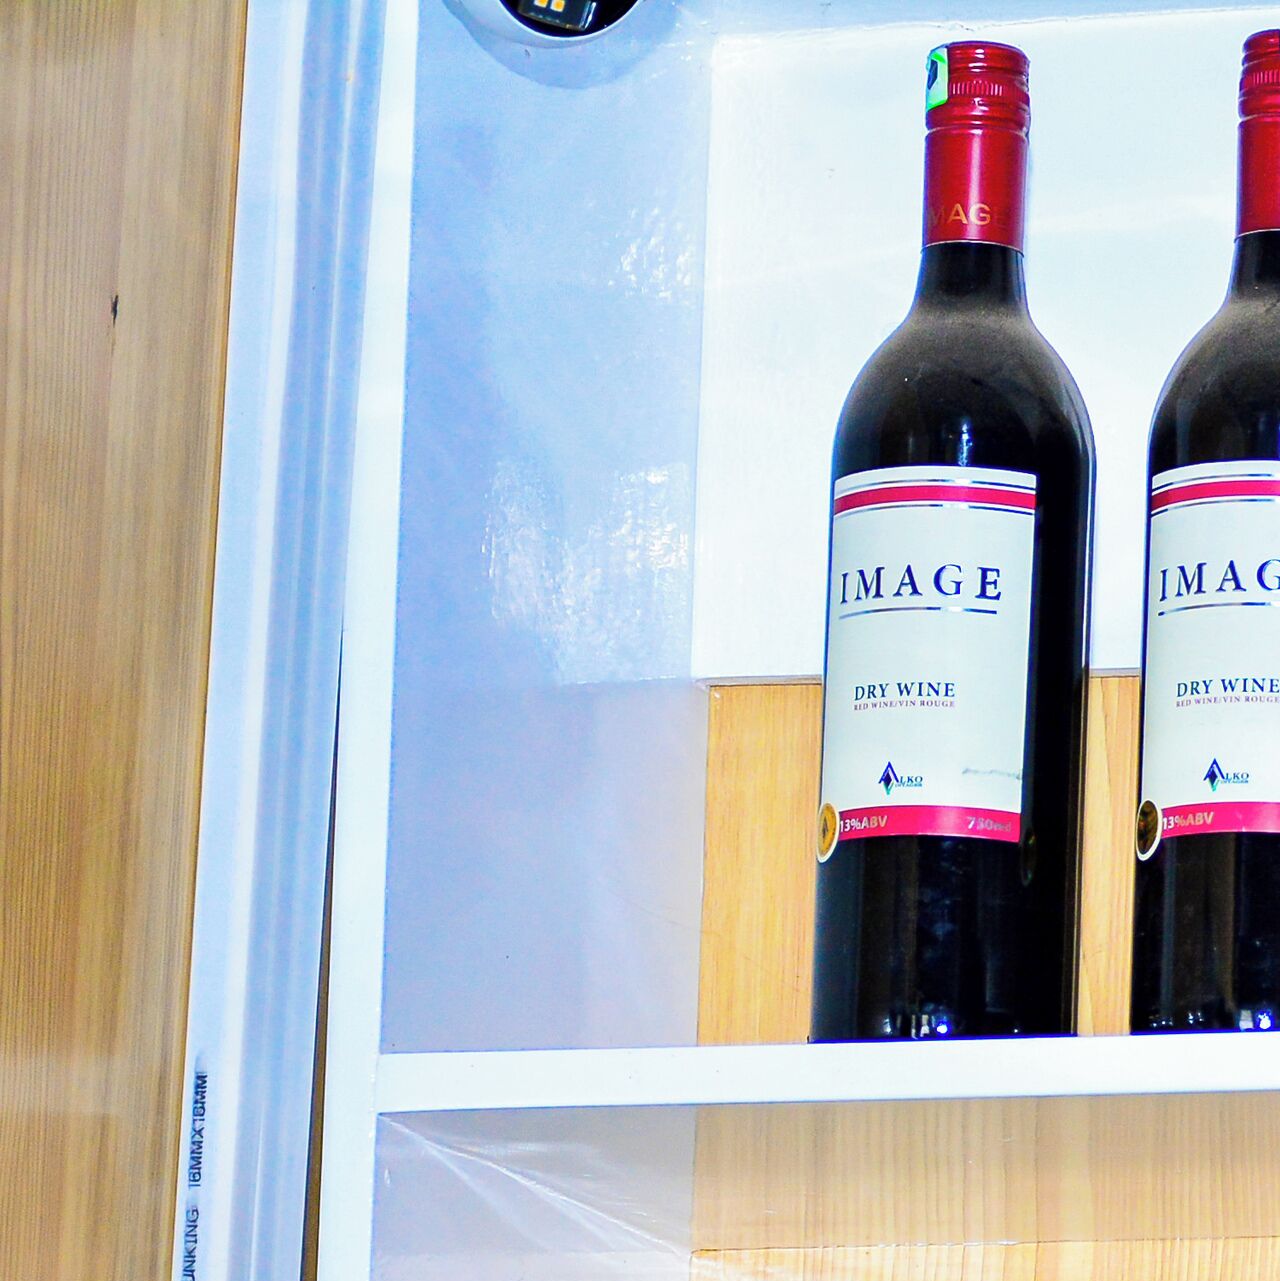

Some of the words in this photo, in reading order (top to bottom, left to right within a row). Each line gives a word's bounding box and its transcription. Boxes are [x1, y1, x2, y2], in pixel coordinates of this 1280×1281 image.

[840, 564, 1002, 604] IMAGE
[854, 683, 890, 701] DRY
[896, 682, 956, 698] WINE
[1177, 679, 1214, 697] DRY
[1220, 678, 1280, 694] WINE
